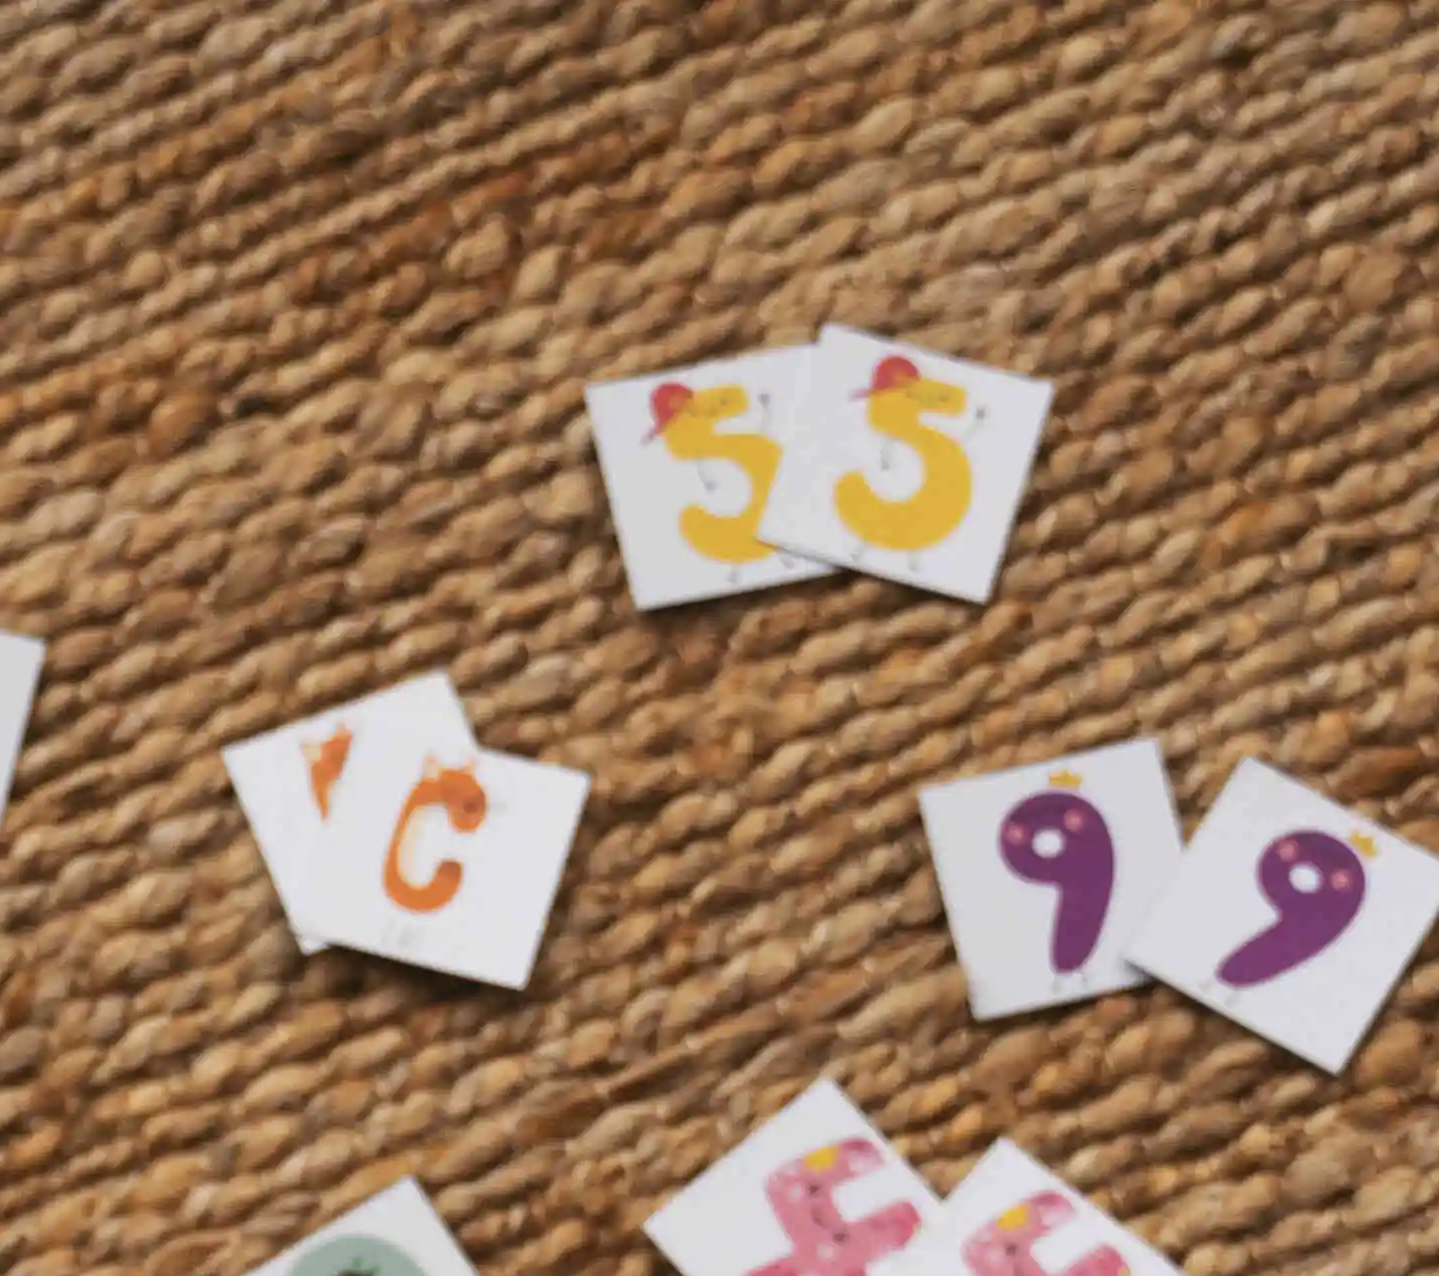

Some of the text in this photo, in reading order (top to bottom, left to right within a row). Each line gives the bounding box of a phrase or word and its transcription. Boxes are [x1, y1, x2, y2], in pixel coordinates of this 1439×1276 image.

[833, 357, 973, 550] 5
[998, 790, 1114, 974] 9
[1216, 829, 1366, 988] 9
